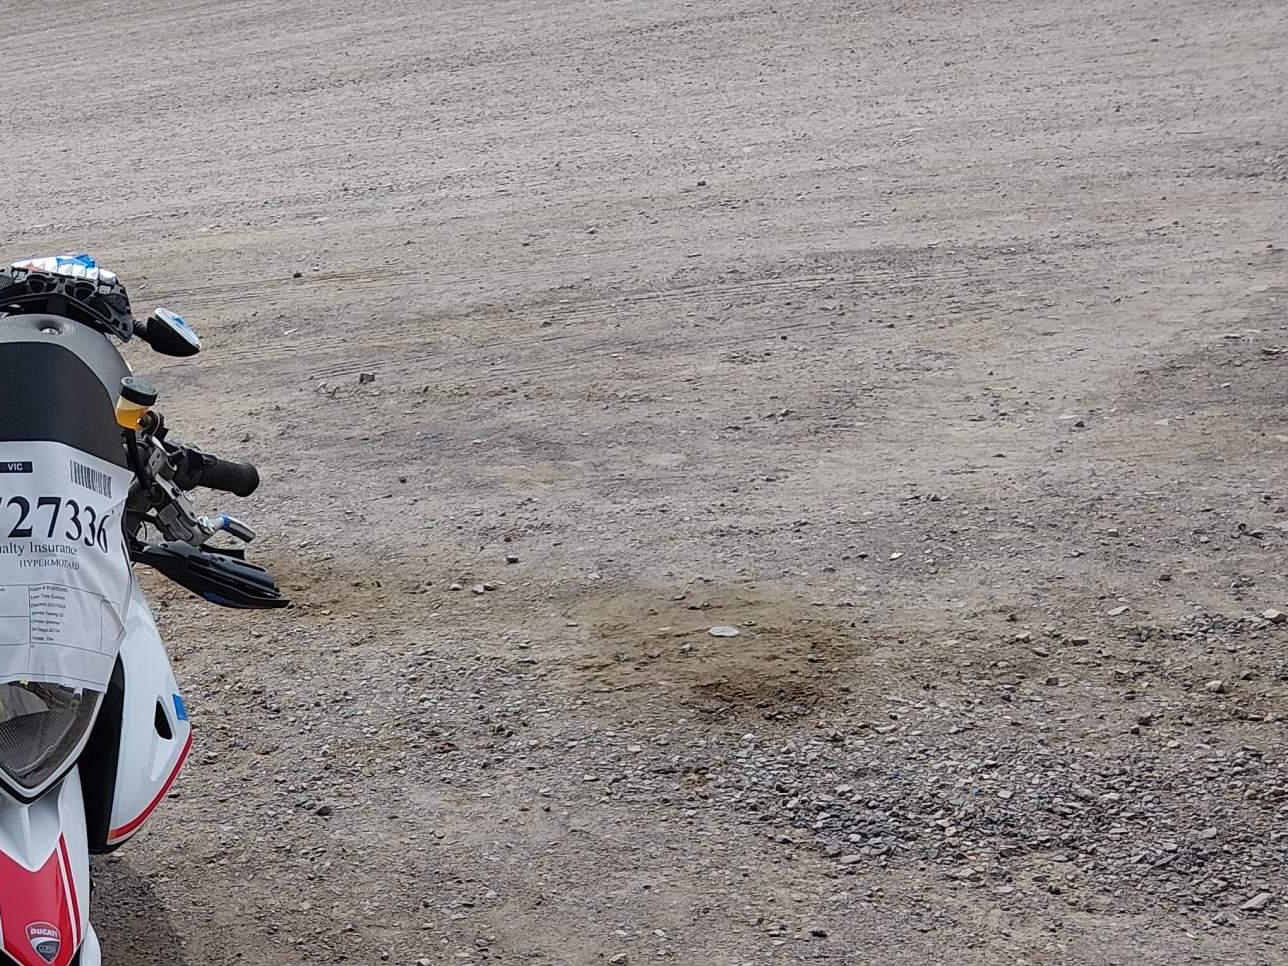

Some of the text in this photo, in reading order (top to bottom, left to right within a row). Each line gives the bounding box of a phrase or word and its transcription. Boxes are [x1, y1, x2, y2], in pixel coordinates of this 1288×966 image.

[8, 463, 23, 471] VIC
[19, 558, 80, 570] HYPERMOTARD
[30, 927, 58, 938] DUCATI
